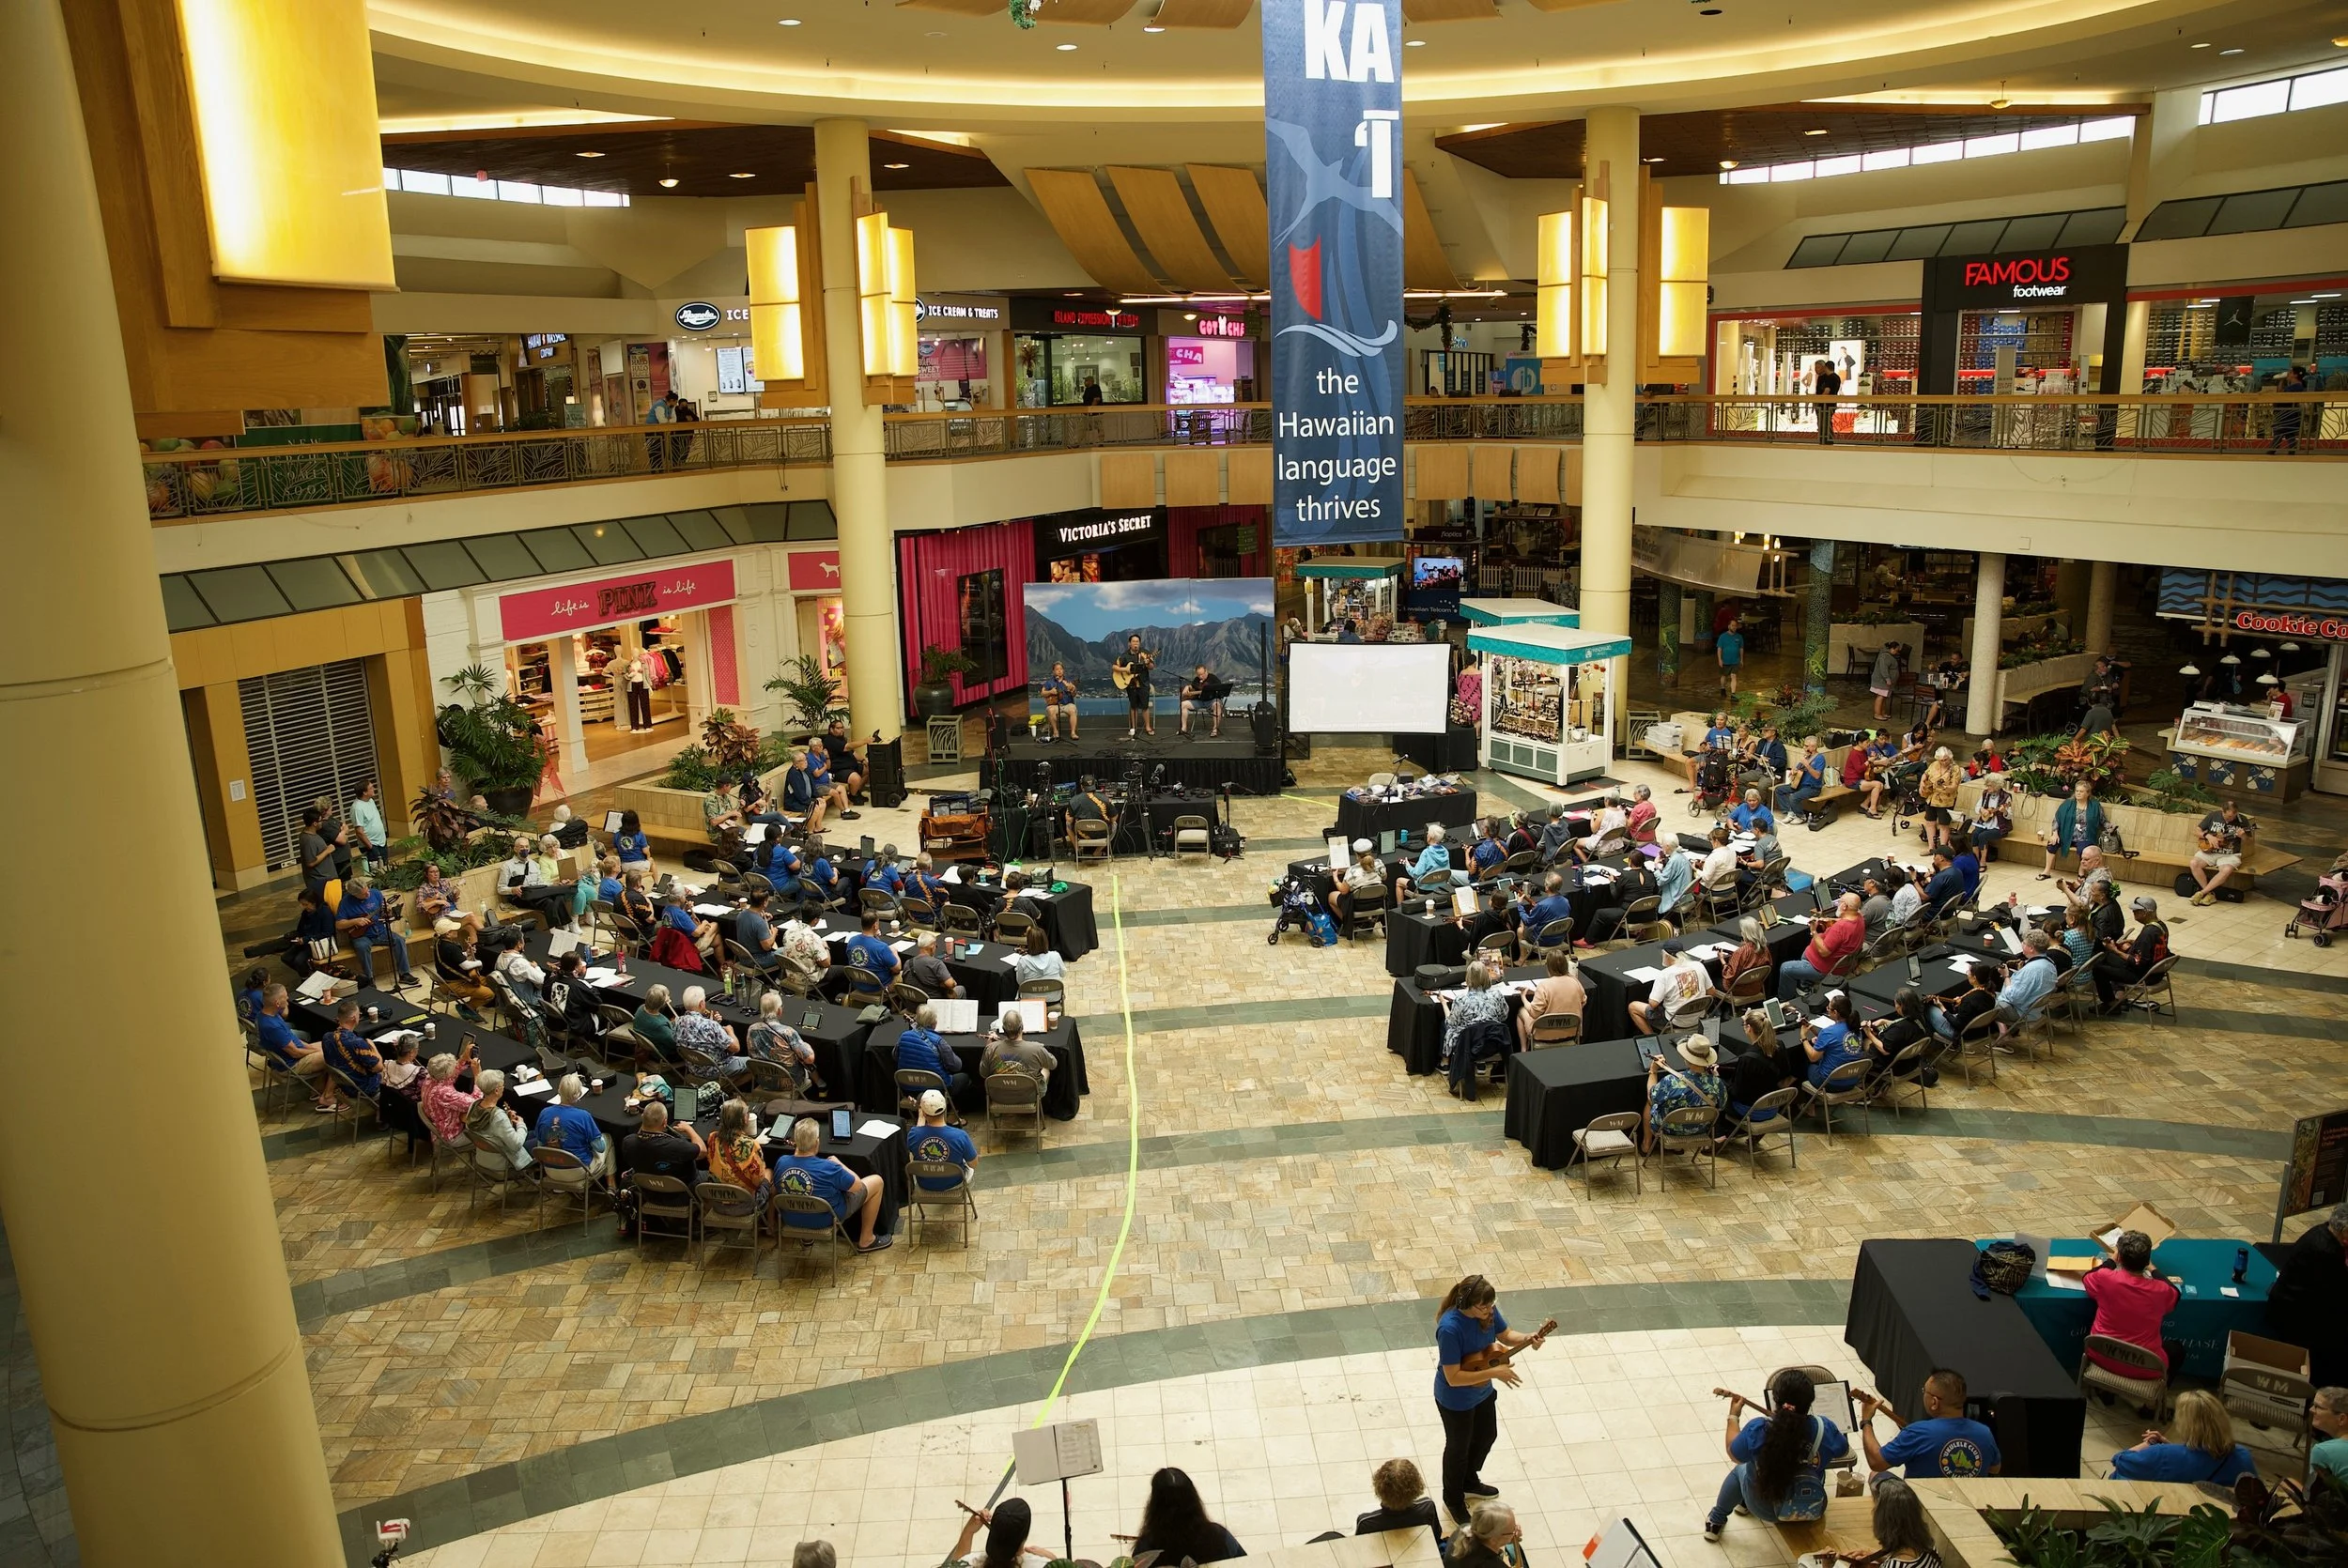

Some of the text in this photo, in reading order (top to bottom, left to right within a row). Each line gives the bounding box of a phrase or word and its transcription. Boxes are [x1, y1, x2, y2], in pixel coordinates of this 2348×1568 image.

[1304, 0, 1394, 83] KA
[1965, 256, 2070, 286] FAMOUS
[2013, 284, 2066, 298] footwear
[726, 309, 749, 321] ICE
[928, 305, 998, 319] ICE CREAM & TREATS
[1054, 310, 1076, 324] ISLAND
[1176, 348, 1203, 363] CHA
[1317, 367, 1359, 394] the
[1279, 410, 1394, 438] Hawaiian
[1278, 453, 1397, 484] language
[1296, 495, 1381, 522] thrives
[1059, 515, 1151, 543] VICTORIA'S SECRET
[551, 578, 697, 617] life is PINK is life
[1429, 606, 1452, 614] Telcom
[2236, 611, 2318, 636] Cookie
[1547, 1018, 1571, 1027] WWM
[1685, 1112, 1705, 1121] WM
[2256, 1375, 2290, 1393] WM
[1968, 1444, 1980, 1460] CLUB
[1943, 1466, 1953, 1475] OF
